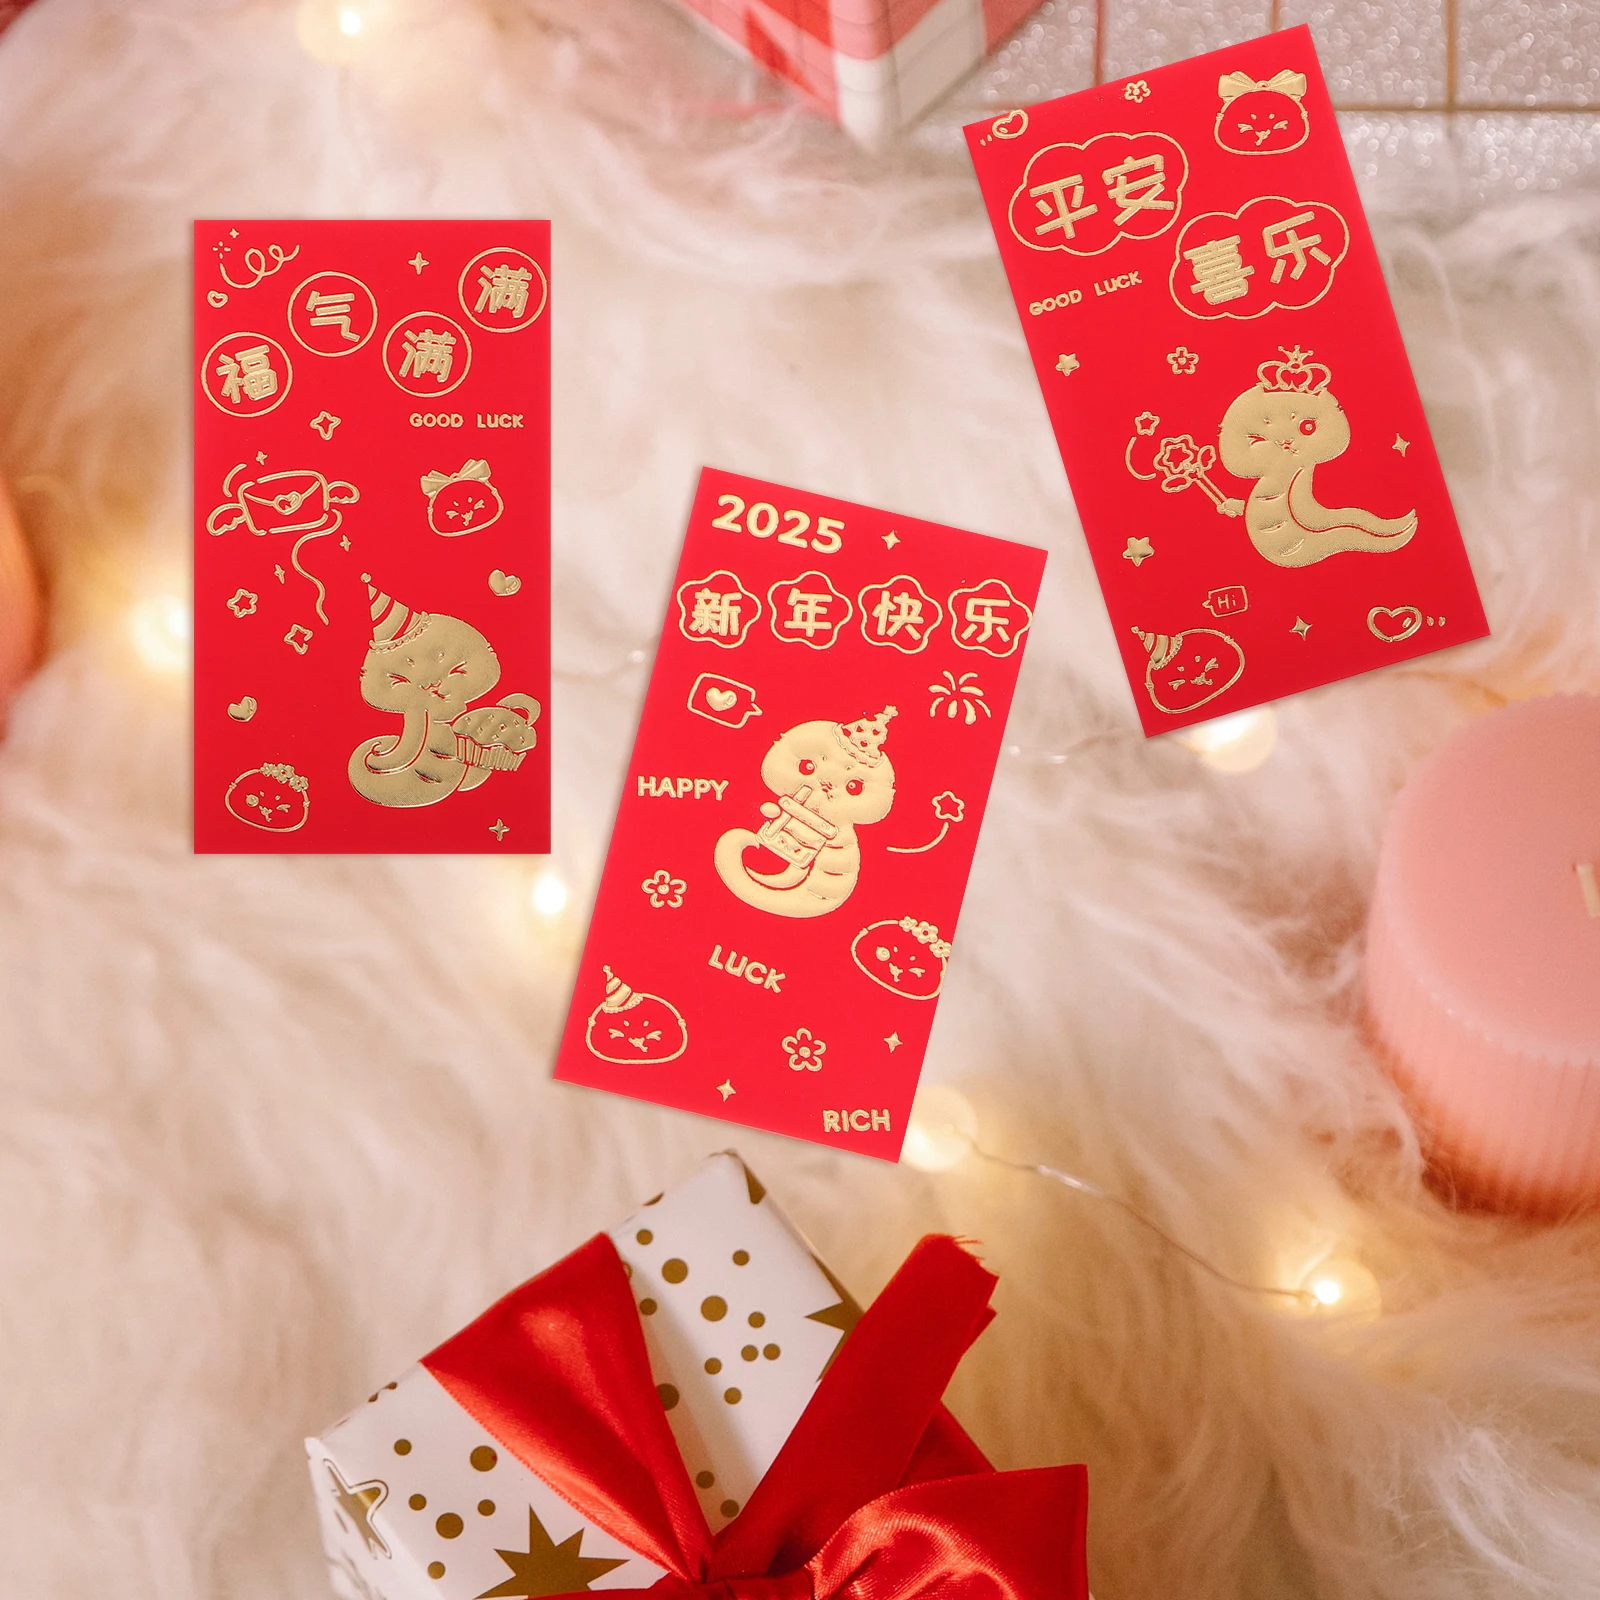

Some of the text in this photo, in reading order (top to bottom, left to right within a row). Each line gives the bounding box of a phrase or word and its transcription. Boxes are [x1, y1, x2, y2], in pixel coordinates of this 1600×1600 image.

[1029, 154, 1174, 239] 平安
[1184, 211, 1332, 306] 喜乐
[1029, 270, 1143, 316] GOOD LUCK
[409, 413, 524, 428] GOOD LUCK
[711, 494, 846, 554] 2025
[1217, 594, 1237, 610] Hi
[637, 775, 730, 801] HAPPY
[708, 944, 786, 994] LUCK
[822, 1108, 891, 1133] RICH
